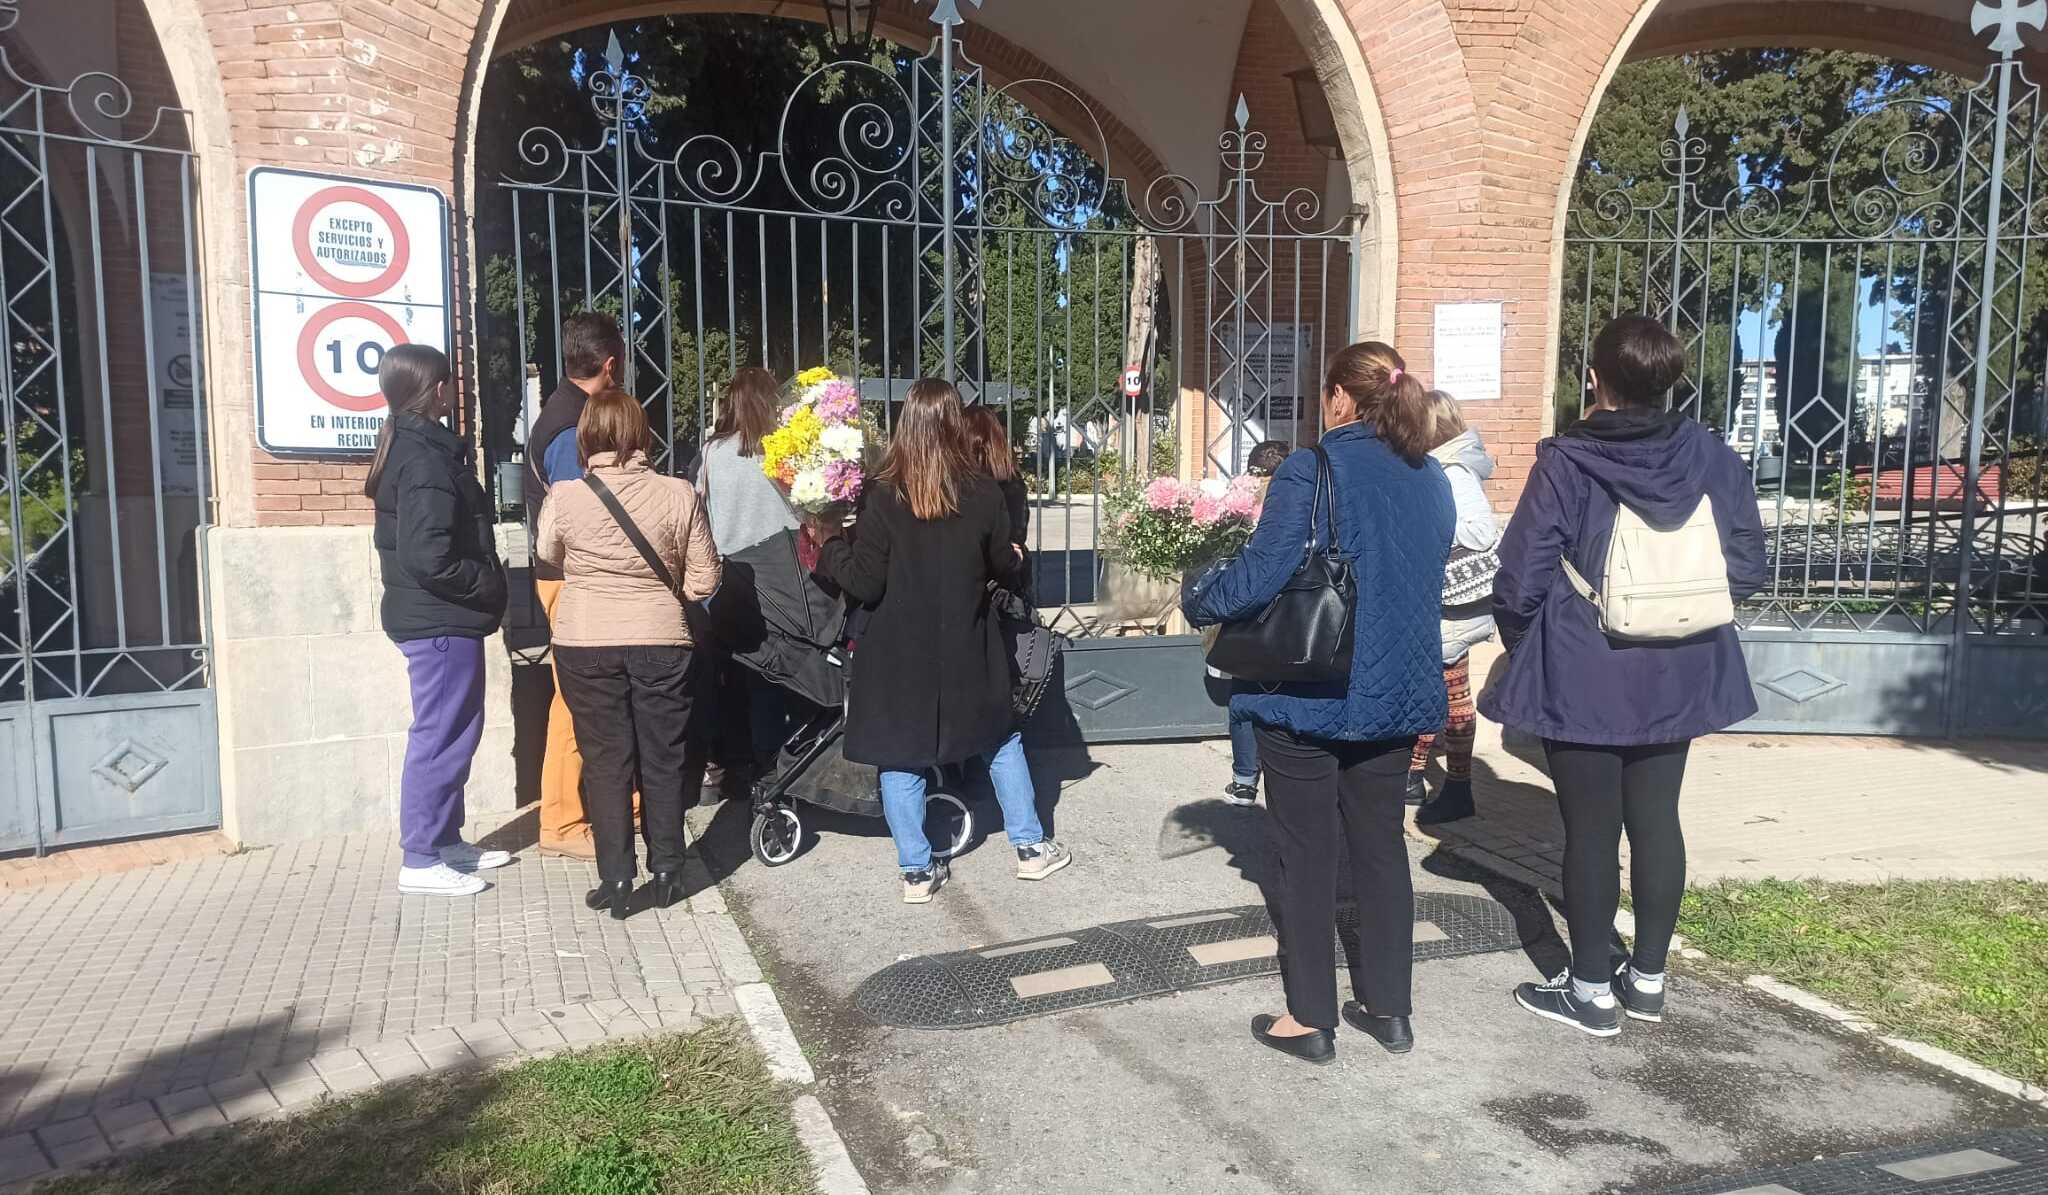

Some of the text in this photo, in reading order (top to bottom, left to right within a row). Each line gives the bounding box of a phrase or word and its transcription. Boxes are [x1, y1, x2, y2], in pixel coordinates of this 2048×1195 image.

[329, 217, 373, 233] EXCEPTO
[318, 231, 384, 249] SERVICIOS Y
[316, 246, 387, 264] AUTORIZADOS
[326, 340, 385, 375] 10
[1127, 376, 1141, 385] 10
[310, 415, 325, 428] EN
[338, 433, 377, 447] RECINT
